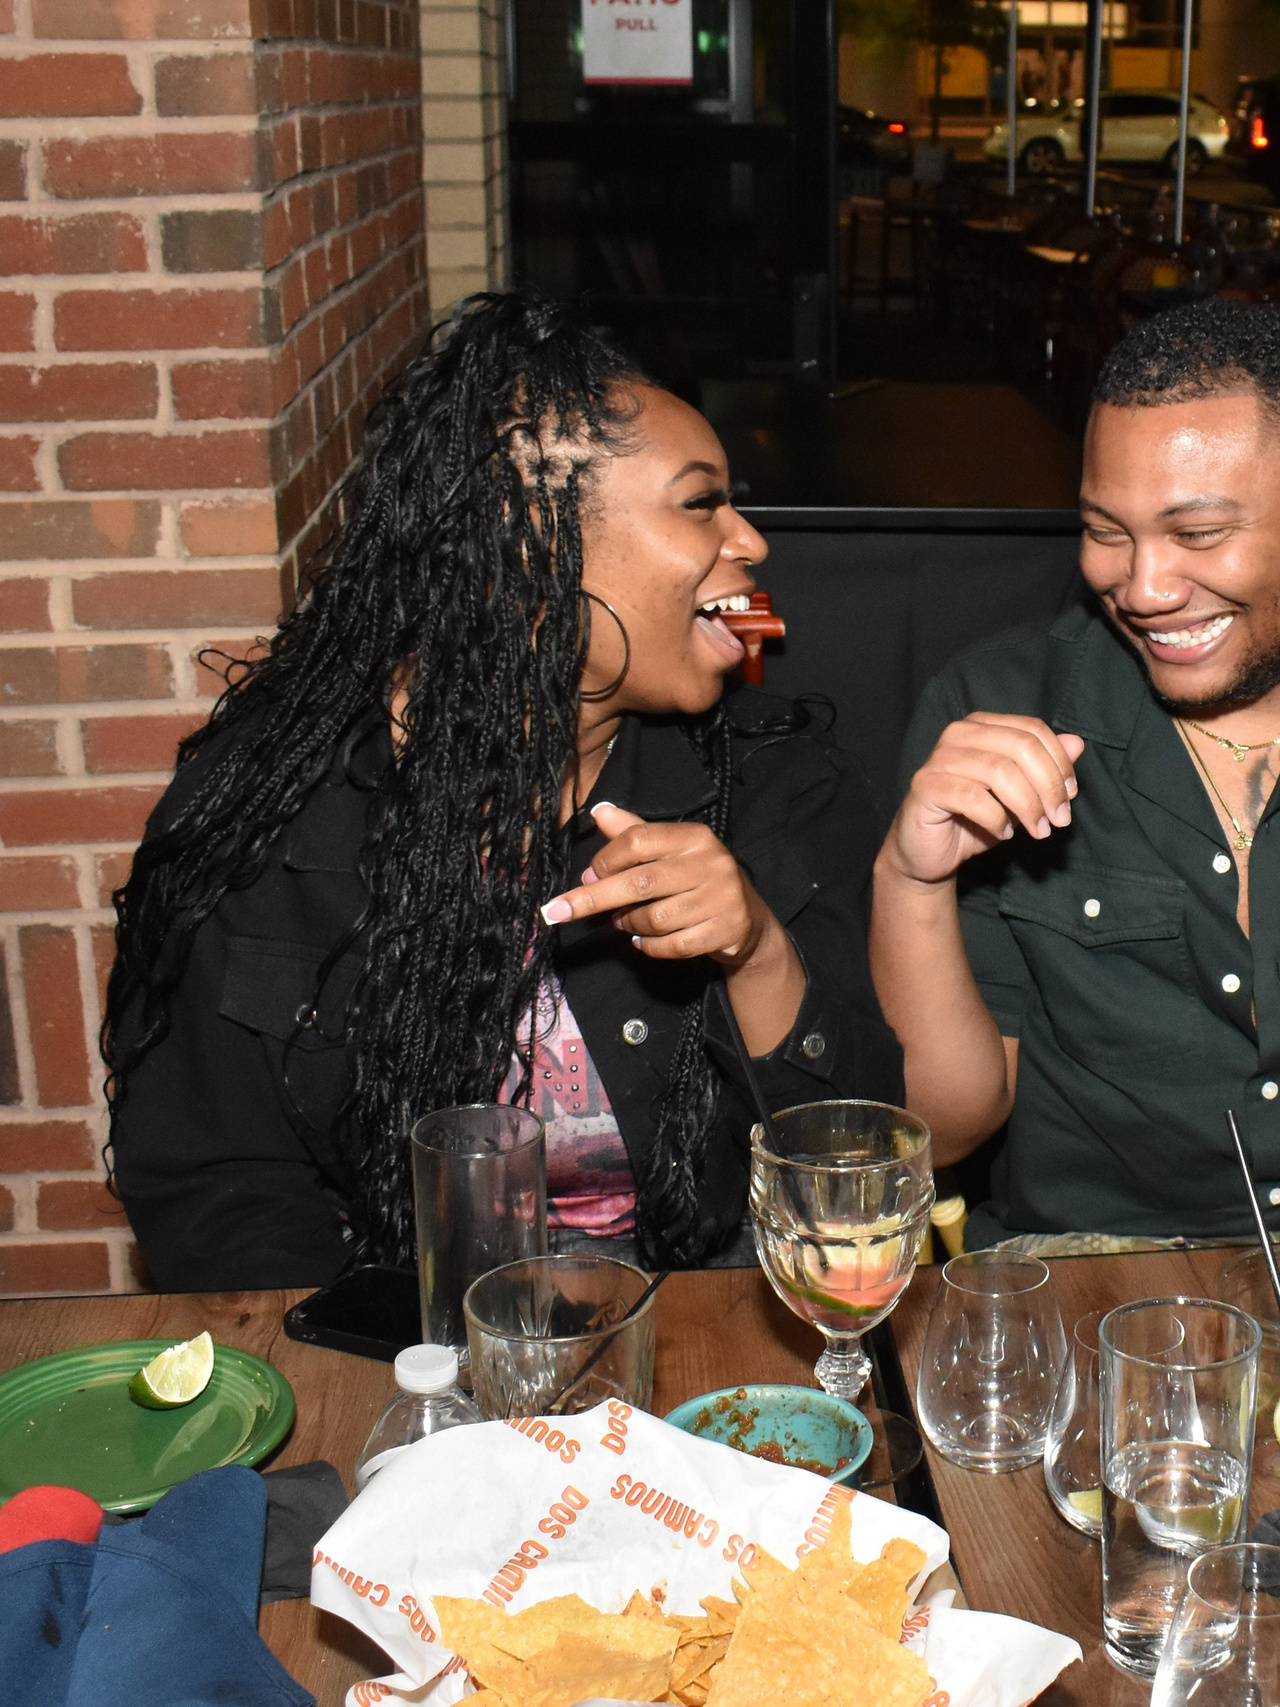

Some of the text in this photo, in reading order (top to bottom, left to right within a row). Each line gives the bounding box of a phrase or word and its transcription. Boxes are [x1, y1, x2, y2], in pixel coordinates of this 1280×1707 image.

[615, 17, 658, 31] PULL
[600, 1401, 633, 1456] DOS
[538, 1485, 590, 1539] DOS
[610, 1474, 757, 1570] OS CAMINOS
